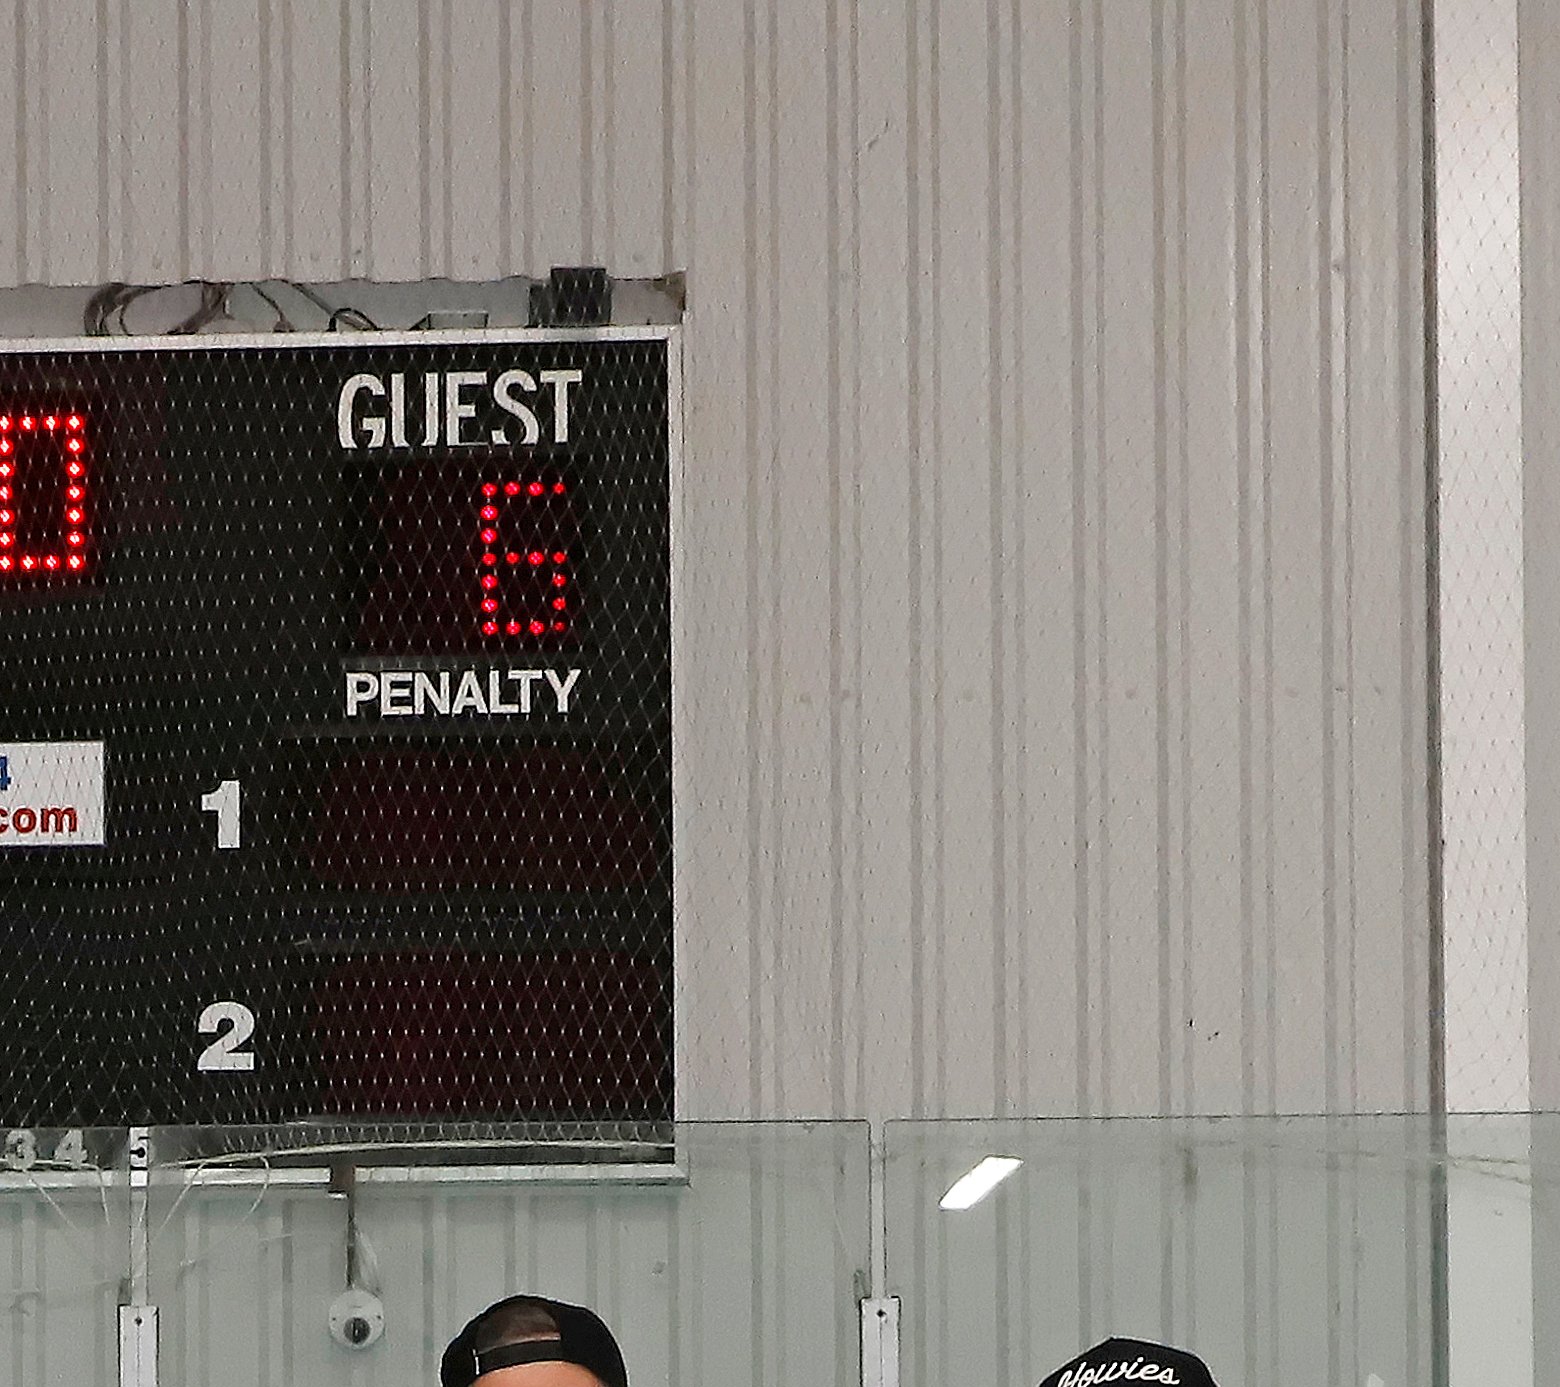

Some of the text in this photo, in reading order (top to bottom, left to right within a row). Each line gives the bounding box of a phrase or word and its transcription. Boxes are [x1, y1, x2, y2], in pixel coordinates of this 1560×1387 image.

[338, 371, 582, 449] GUEST
[480, 481, 568, 637] 6
[346, 669, 582, 717] PENALTY
[201, 781, 240, 849] 1
[198, 1002, 255, 1072] 2
[54, 1130, 87, 1167] 4
